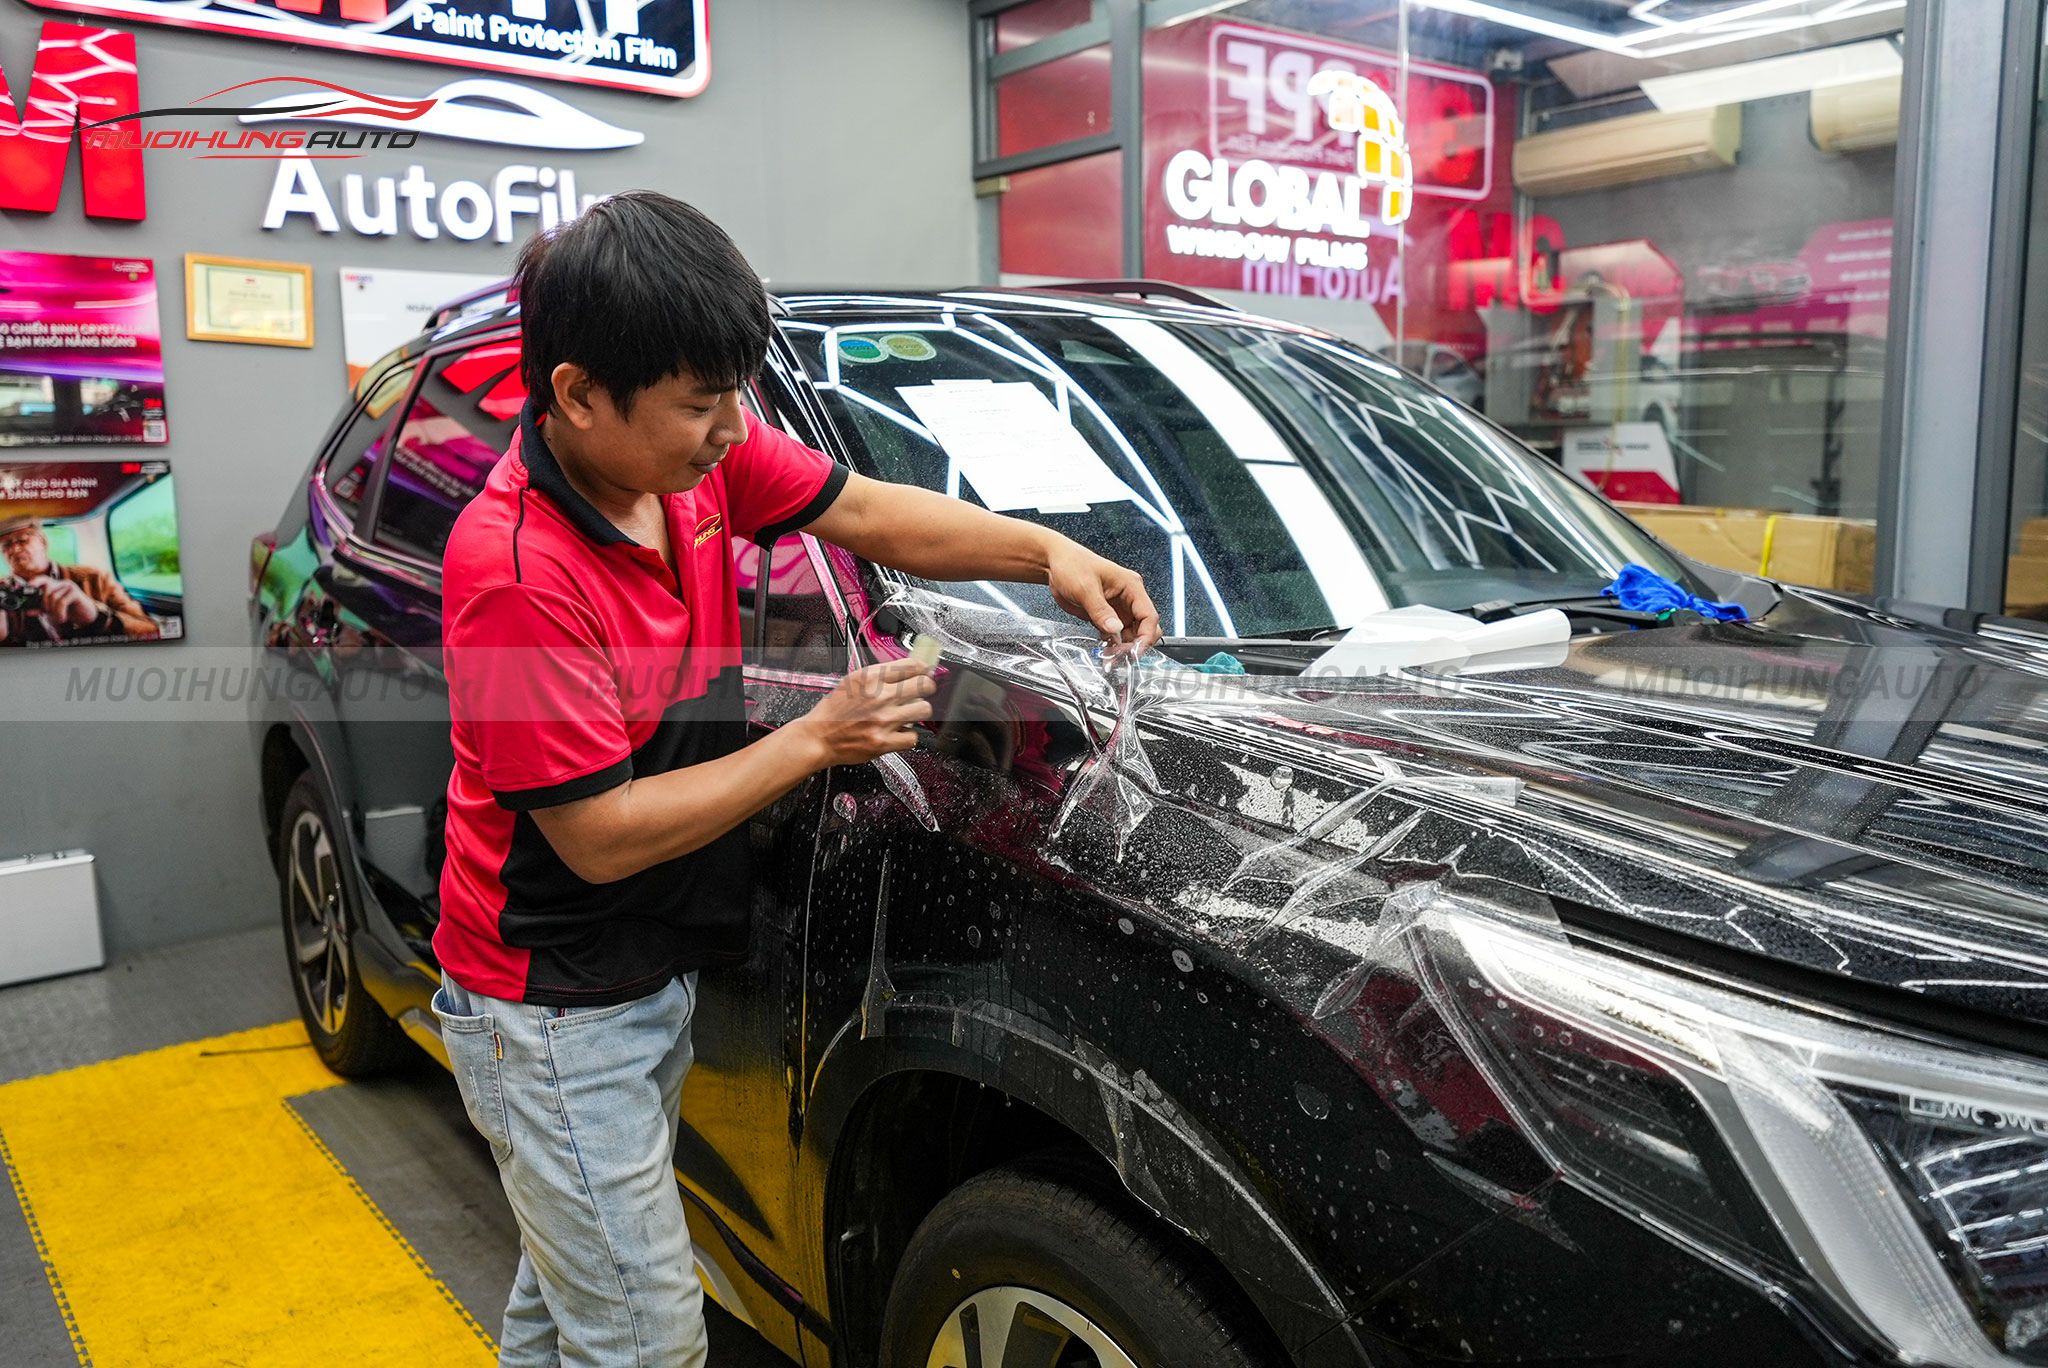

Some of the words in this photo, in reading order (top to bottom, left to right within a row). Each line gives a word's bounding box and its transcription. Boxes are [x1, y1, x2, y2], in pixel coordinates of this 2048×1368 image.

[412, 2, 485, 41] Paint
[489, 14, 621, 61] Protection
[625, 36, 677, 69] Film
[261, 146, 620, 244] AutoFil
[1165, 150, 1370, 238] GLOBAL
[1167, 225, 1291, 264] WINDOW
[1295, 237, 1368, 271] FILMS
